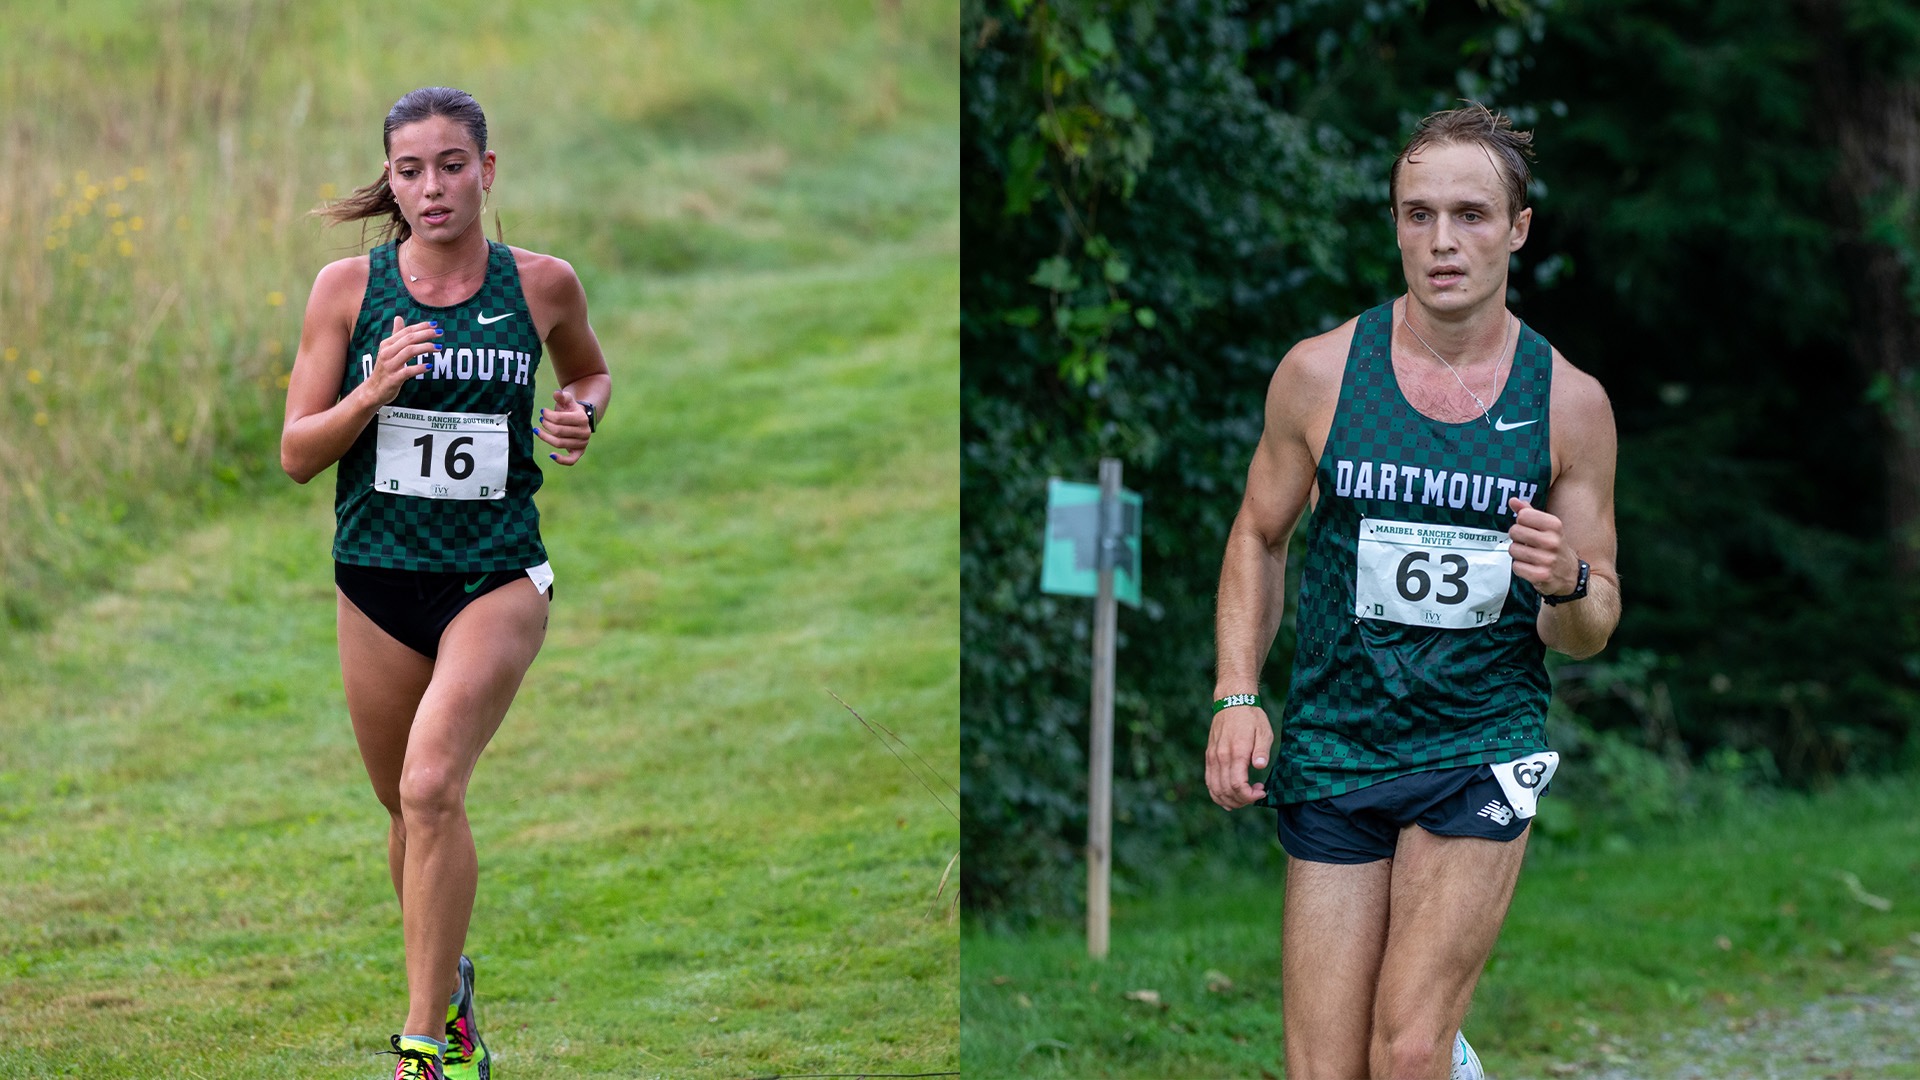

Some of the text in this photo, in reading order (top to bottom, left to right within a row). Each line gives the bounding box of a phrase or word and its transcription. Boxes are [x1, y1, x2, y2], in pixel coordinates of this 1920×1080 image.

[362, 348, 531, 386] DTMOUTH
[392, 411, 495, 425] MARIBEL SANCHEZ SOUTHER
[431, 422, 458, 430] INVITE
[413, 433, 475, 481] 16
[390, 479, 399, 491] D
[434, 486, 450, 494] IVY
[479, 486, 489, 497] D
[1335, 459, 1539, 518] DARTMOUTH
[1375, 525, 1498, 543] MARIBEL SANCHEZ SOUTHER
[1421, 536, 1452, 546] INVITE
[1395, 550, 1470, 605] 63
[1374, 603, 1384, 616] D
[1425, 612, 1442, 621] IVY
[1512, 760, 1548, 789] 63
